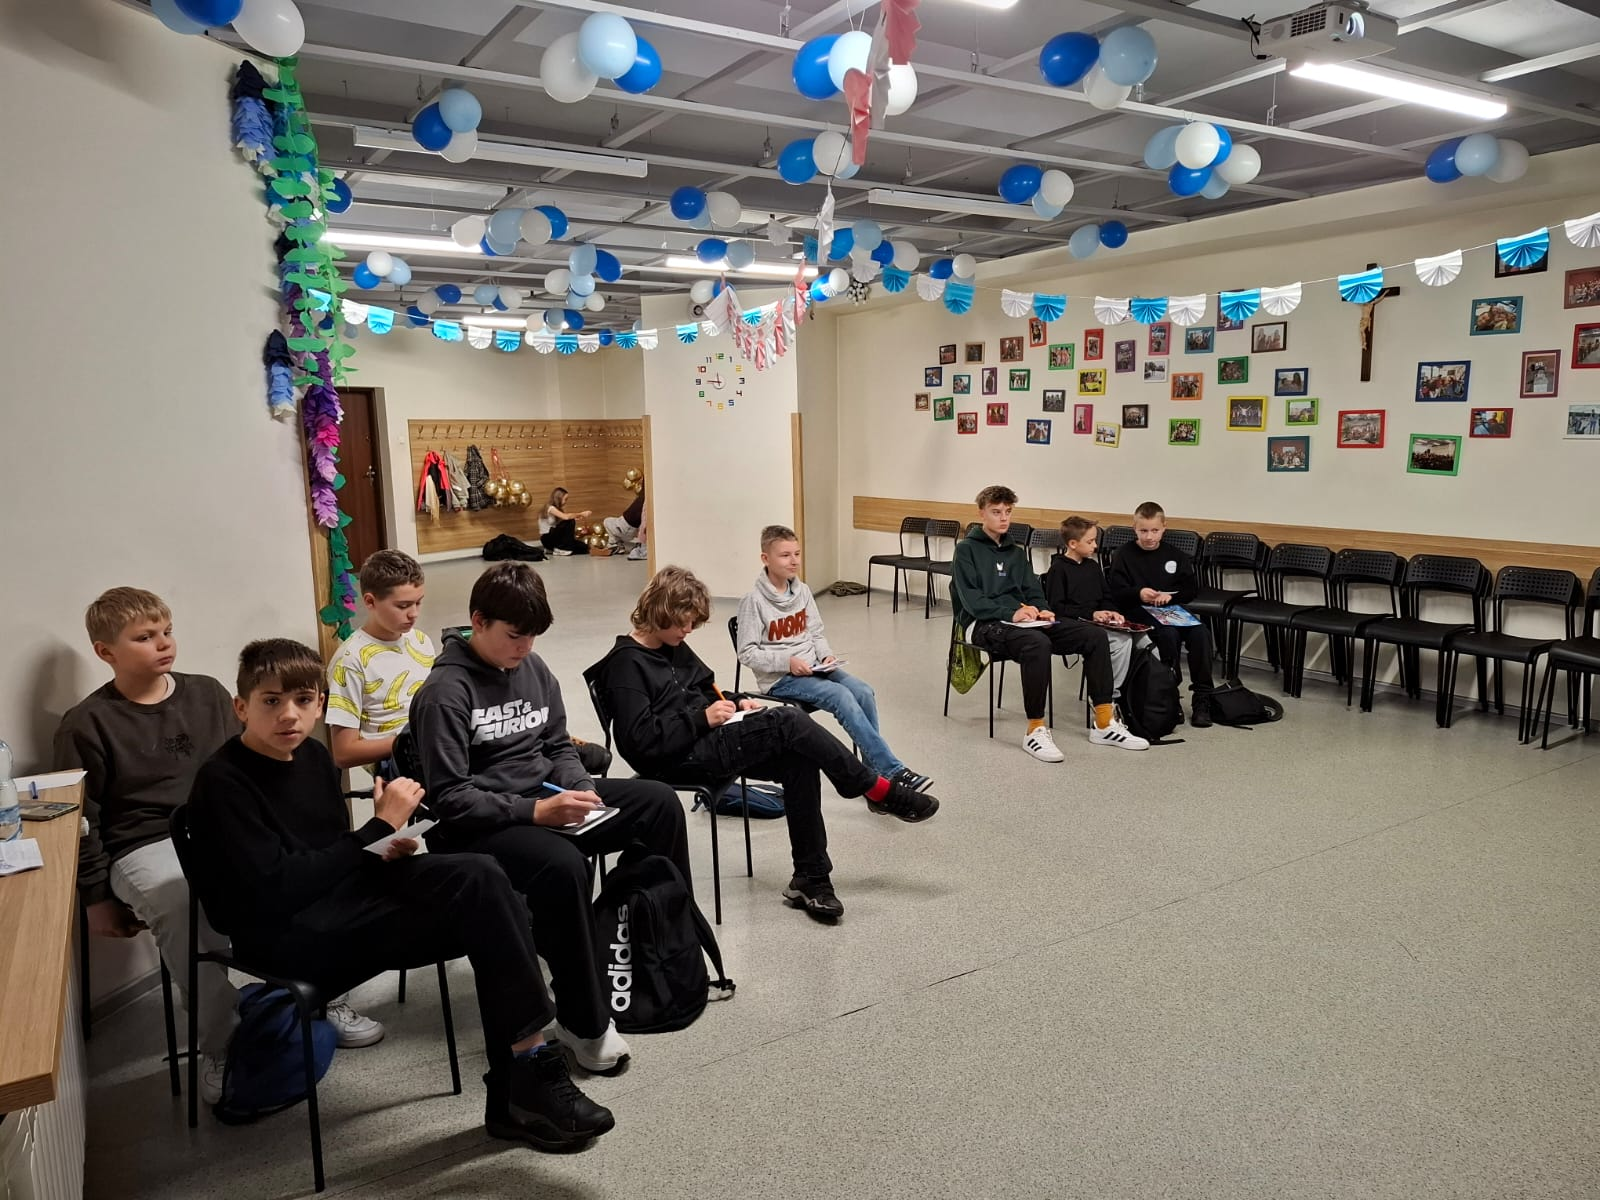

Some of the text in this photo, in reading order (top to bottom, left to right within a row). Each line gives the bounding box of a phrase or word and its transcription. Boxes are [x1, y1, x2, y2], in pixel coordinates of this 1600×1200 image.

[706, 356, 712, 364] 11
[697, 365, 707, 373] 10
[695, 378, 702, 386] 9
[738, 377, 745, 385] 3
[698, 390, 705, 398] 8
[717, 402, 724, 410] 6
[728, 399, 735, 407] 5
[470, 699, 533, 731] FAST &
[607, 903, 633, 1012] adidas
